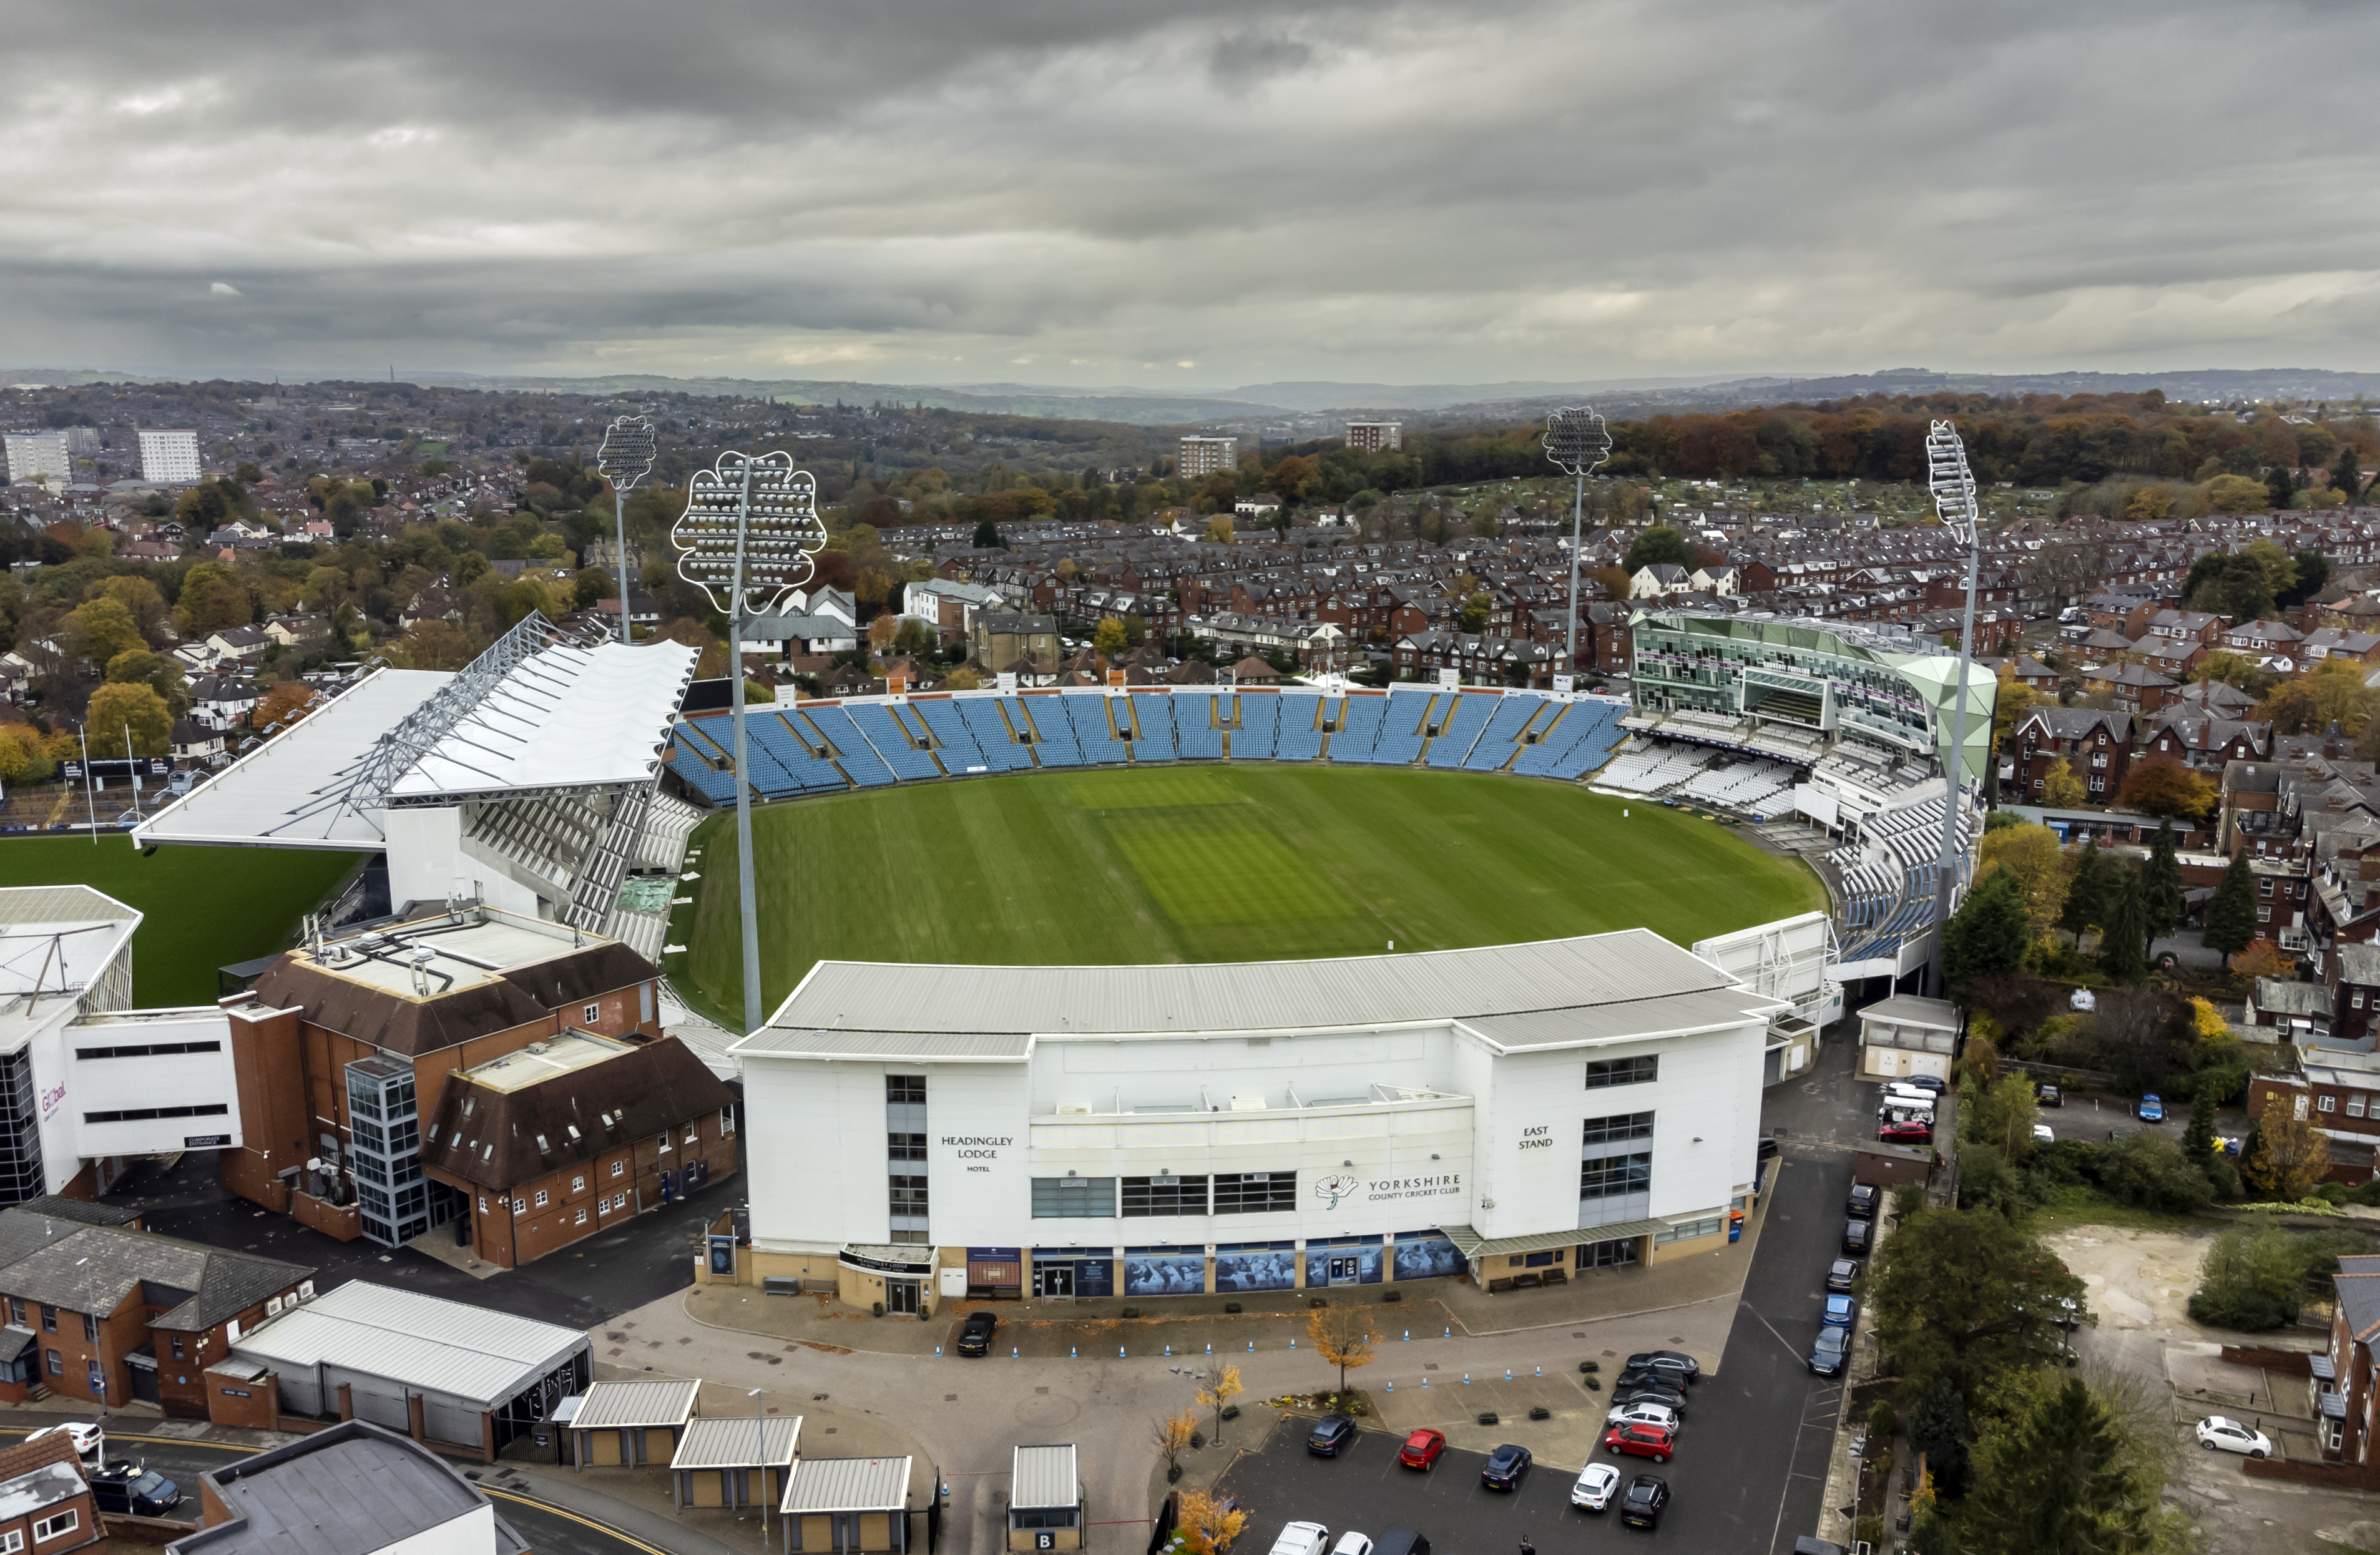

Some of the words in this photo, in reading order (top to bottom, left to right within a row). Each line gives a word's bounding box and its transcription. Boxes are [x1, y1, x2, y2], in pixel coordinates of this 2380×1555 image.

[1524, 1126, 1549, 1136] EAST
[942, 1137, 1013, 1145] HEADINGLEY
[1519, 1139, 1552, 1149] STAND
[958, 1150, 997, 1158] LODGE
[1369, 1174, 1461, 1191] YORKSHIRE
[1369, 1192, 1403, 1200] COUNTY
[1405, 1189, 1437, 1198] CRICKET
[857, 1257, 888, 1267] HEADINGLEY
[1040, 1535, 1050, 1548] B
